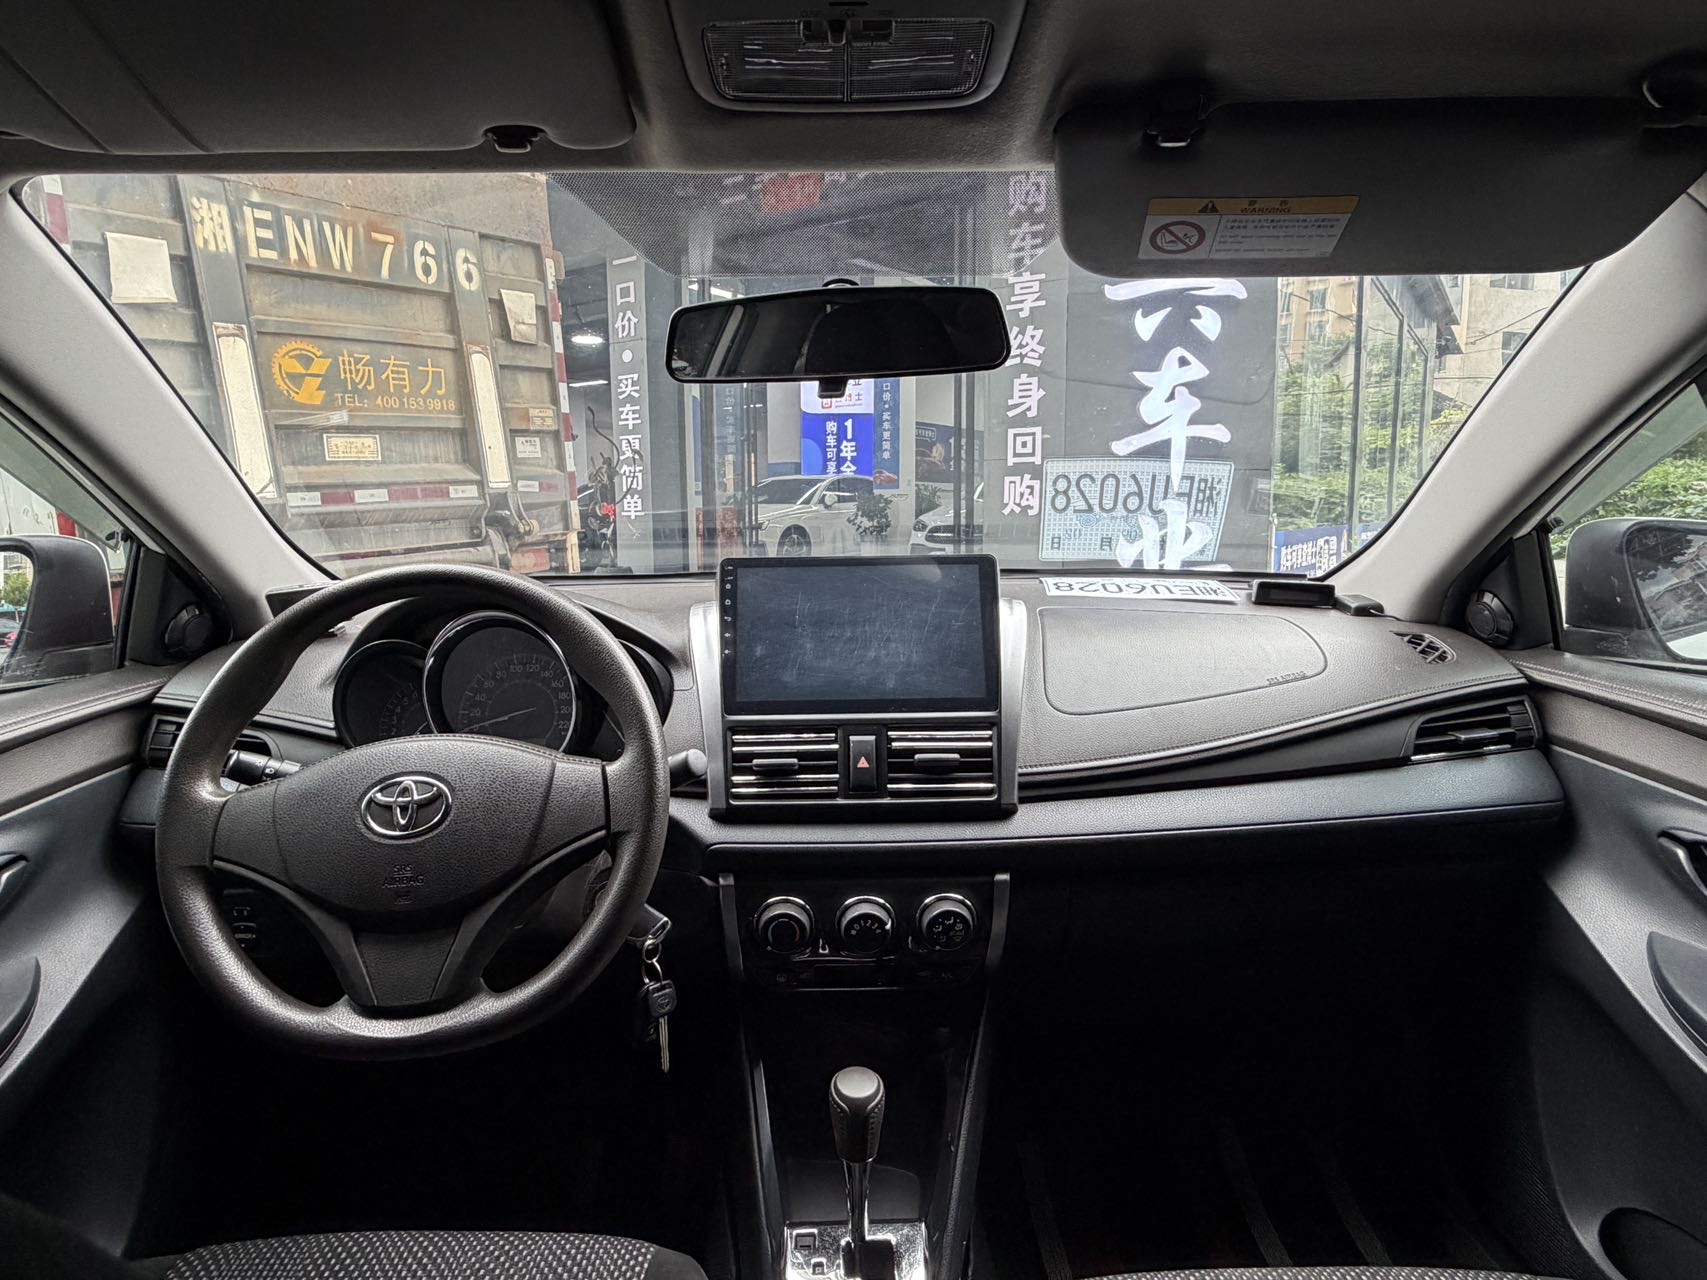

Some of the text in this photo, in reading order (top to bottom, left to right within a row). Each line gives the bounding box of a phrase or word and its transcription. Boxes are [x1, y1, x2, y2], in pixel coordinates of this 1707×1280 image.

[1002, 171, 1046, 516] 购车享终身回购
[338, 348, 446, 396] 畅有力
[335, 393, 368, 408] TEL:
